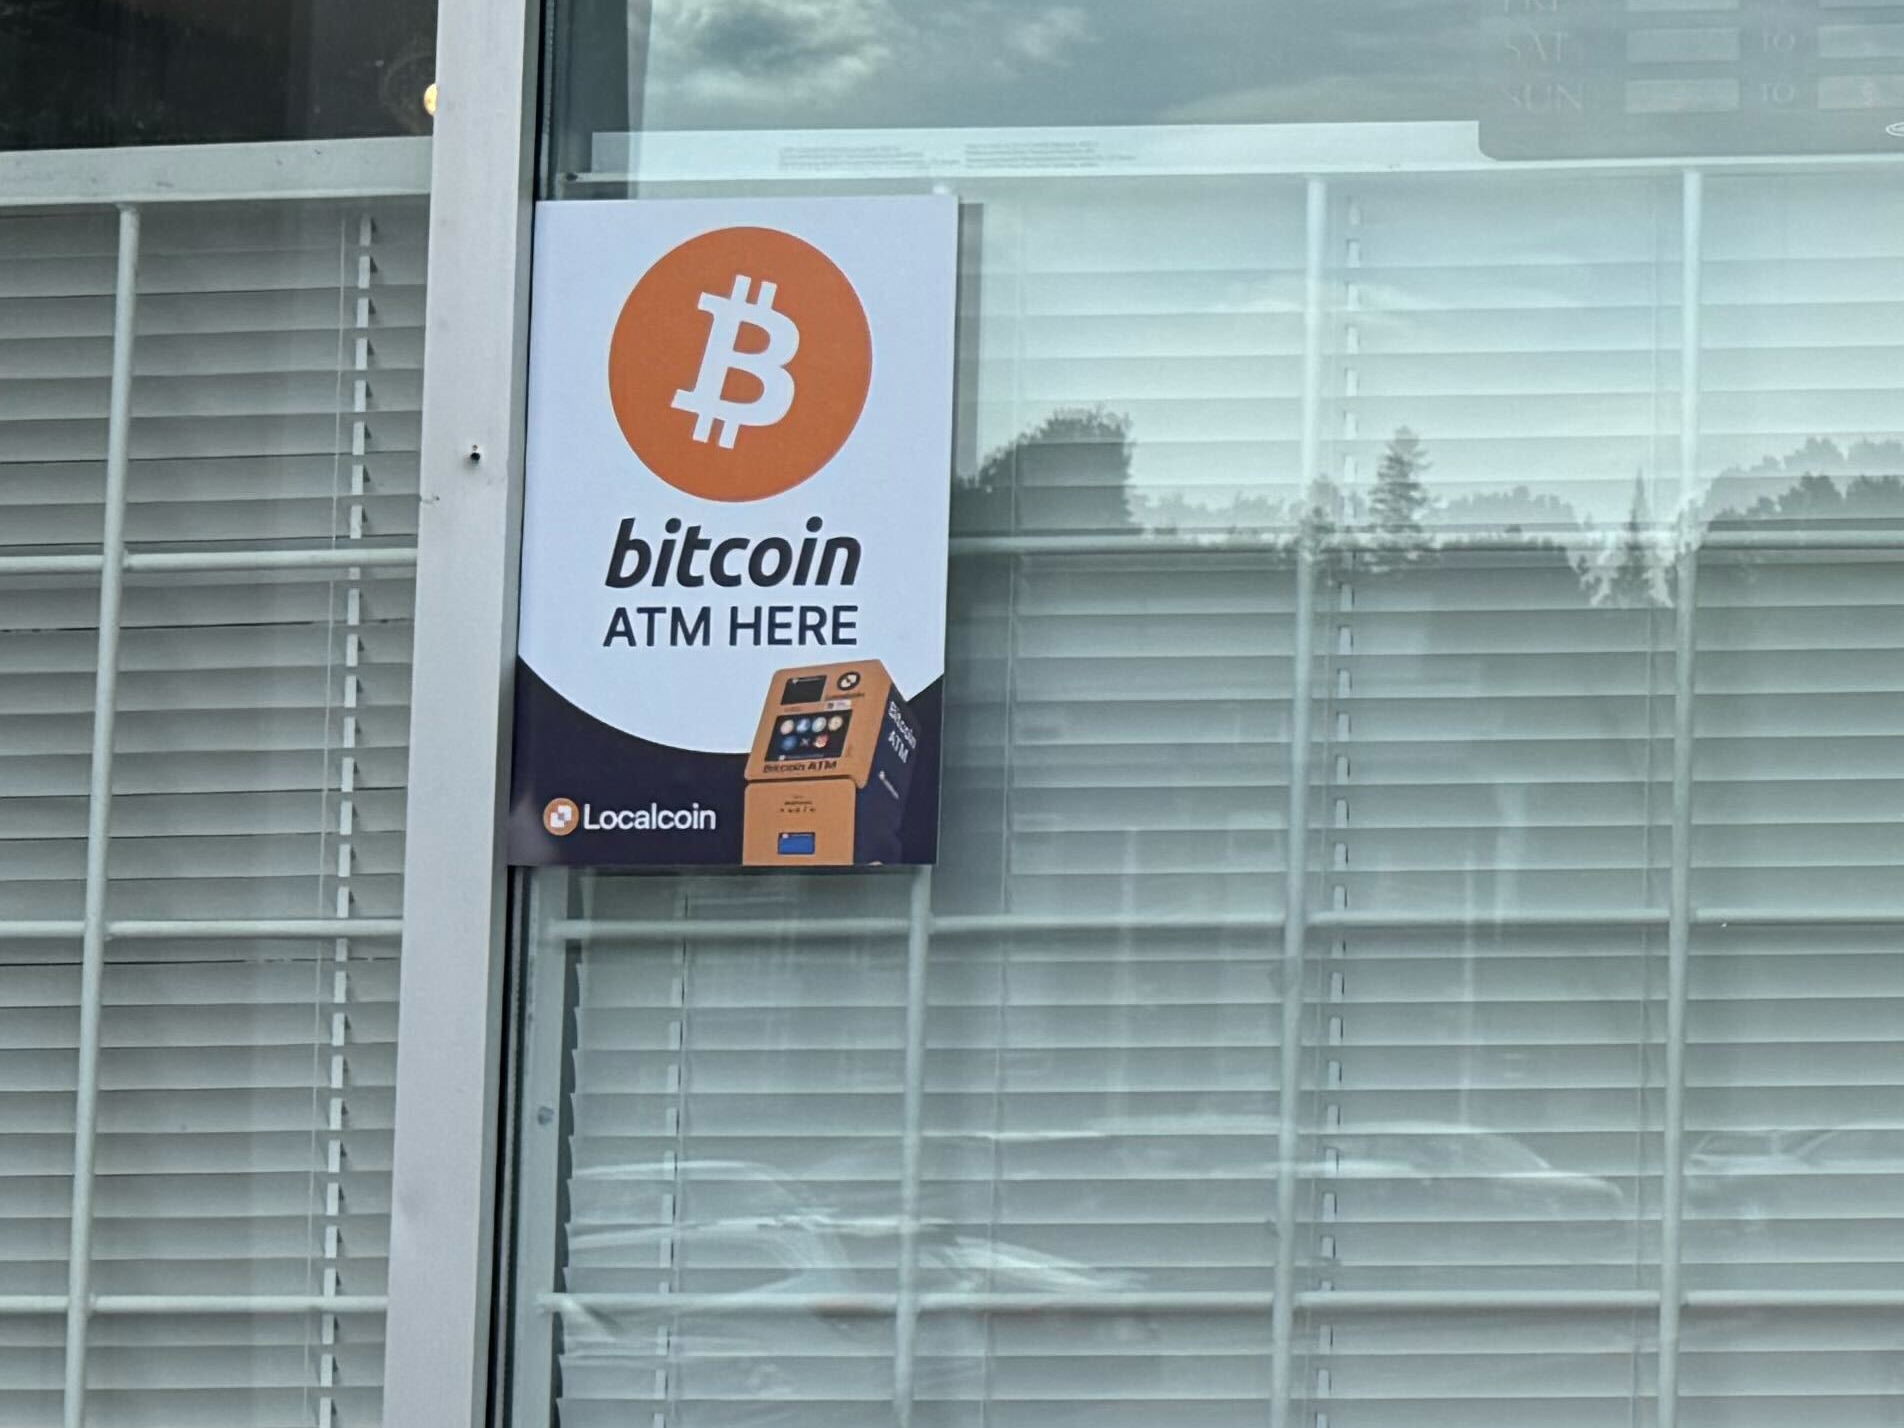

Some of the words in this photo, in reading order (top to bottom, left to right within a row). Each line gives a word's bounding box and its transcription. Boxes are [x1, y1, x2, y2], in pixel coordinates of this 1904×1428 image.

[605, 516, 861, 590] bitcoin
[602, 606, 712, 649] ATM
[729, 604, 859, 647] HERE
[808, 760, 837, 771] ATM
[583, 801, 717, 831] Localcoin
